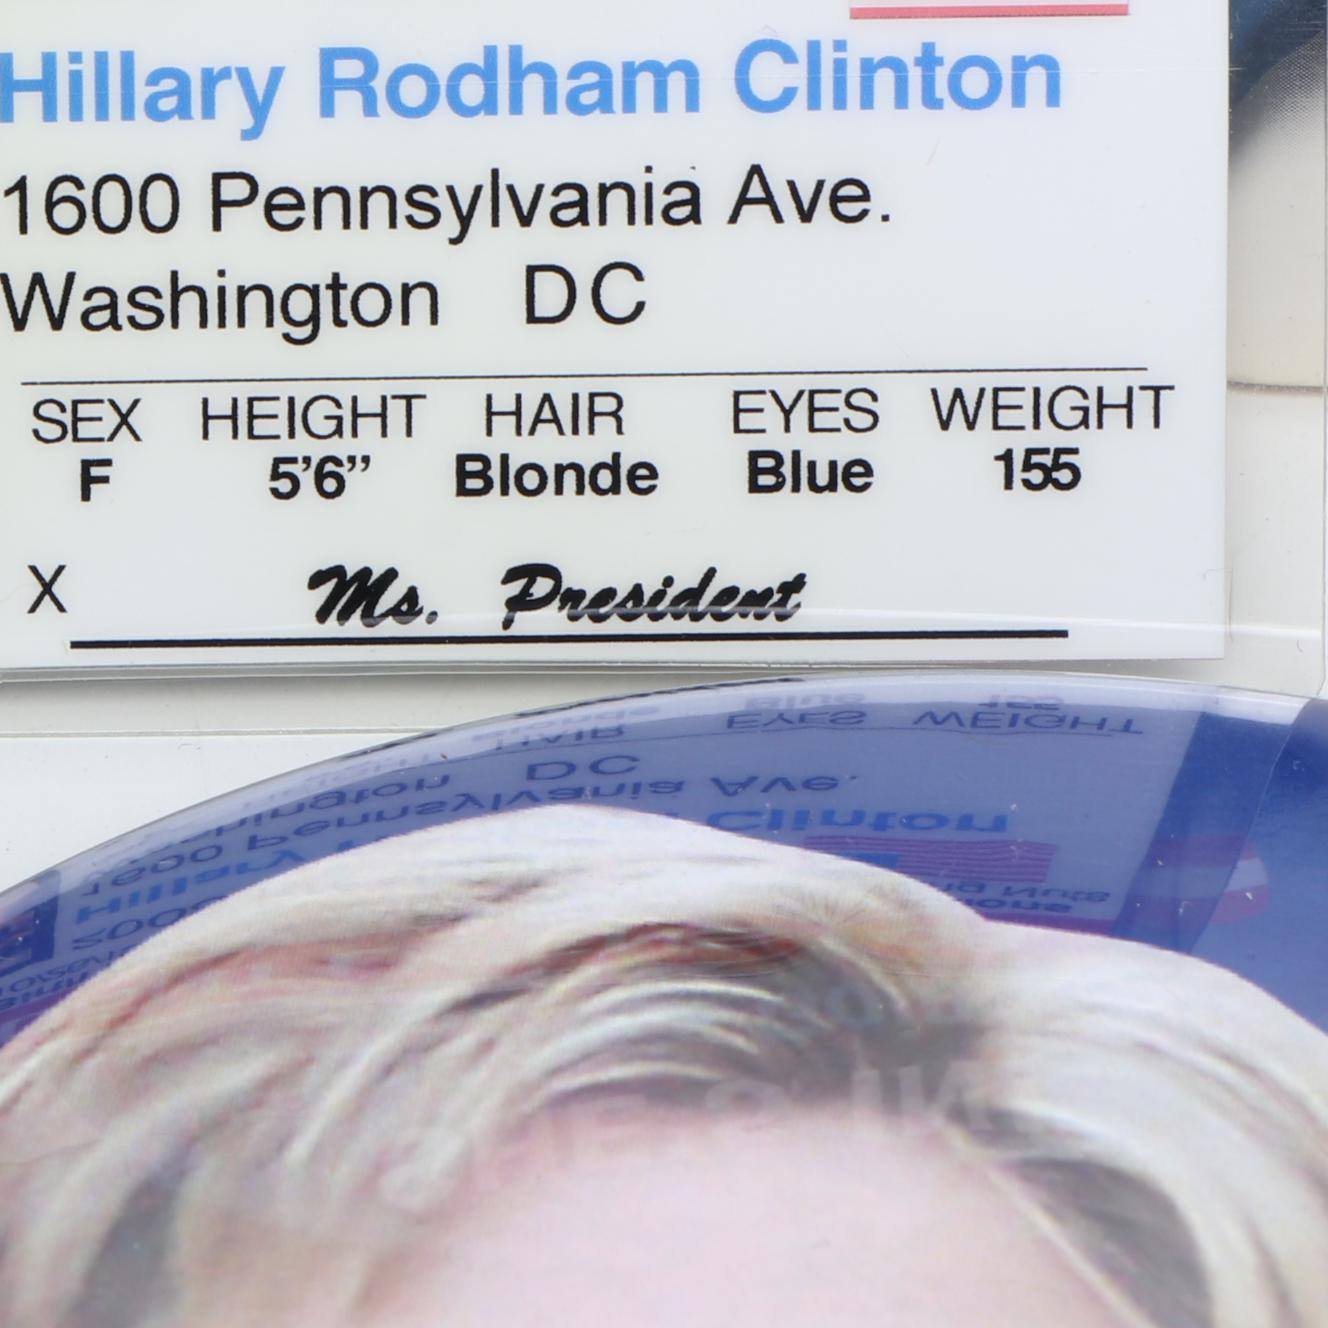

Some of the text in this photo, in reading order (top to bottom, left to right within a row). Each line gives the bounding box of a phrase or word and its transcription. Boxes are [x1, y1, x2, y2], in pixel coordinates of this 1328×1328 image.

[319, 44, 700, 118] Rodham
[734, 37, 1062, 114] Clinton
[3, 162, 891, 246] 1600 Pennsylvania Ave.
[525, 261, 647, 325] DC
[31, 385, 1175, 444] SEX HEIGHT HAIR EYES WEIGHT
[79, 447, 1083, 502] F 5'6" Blonde Blue 155
[27, 563, 807, 631] X Ms. President
